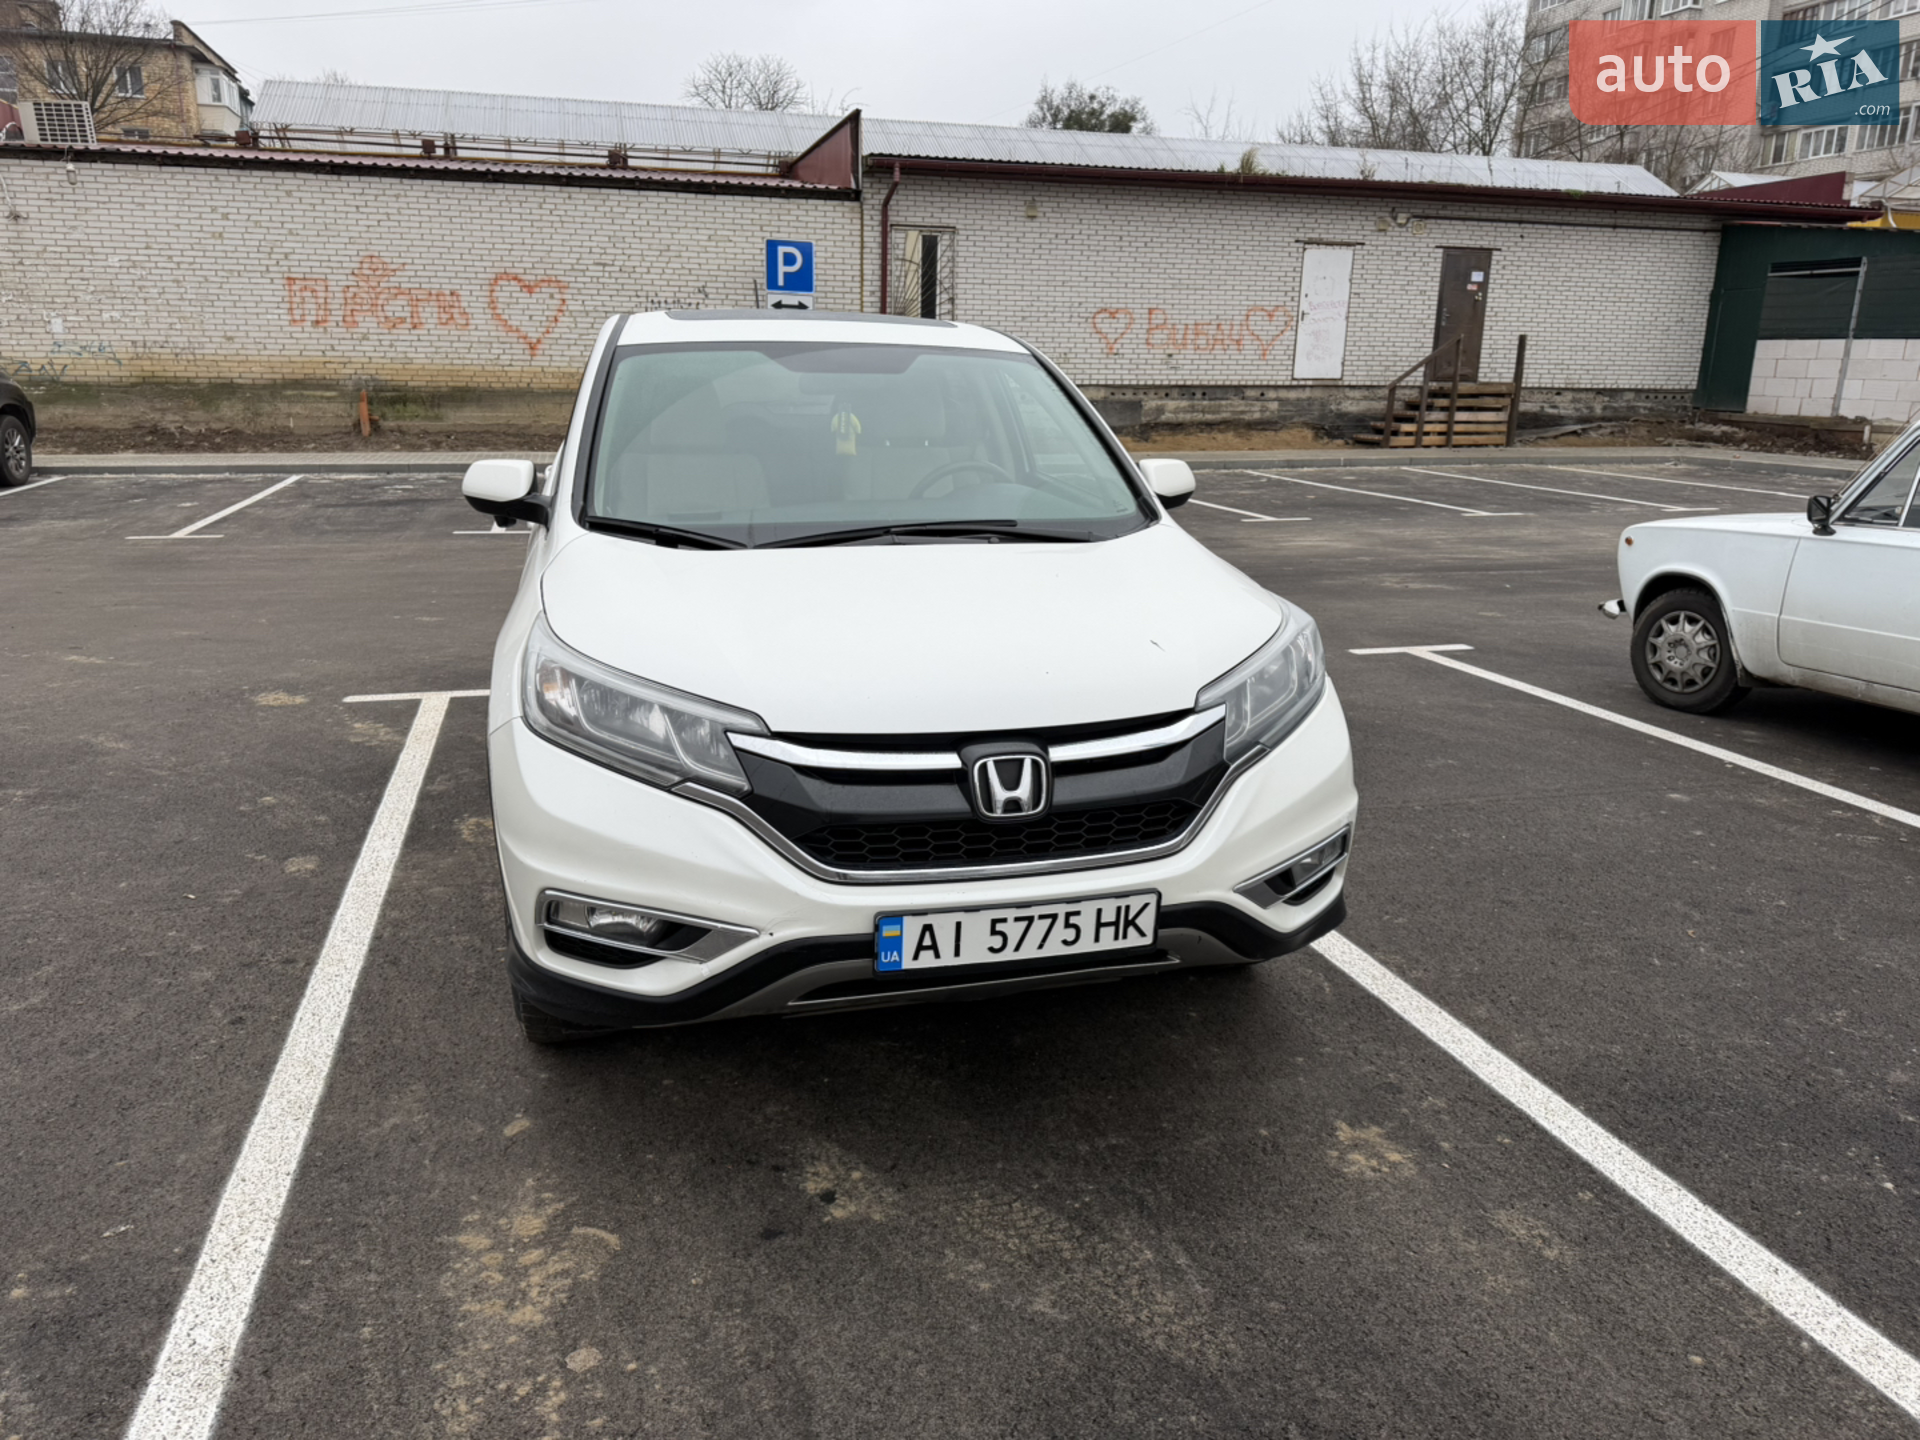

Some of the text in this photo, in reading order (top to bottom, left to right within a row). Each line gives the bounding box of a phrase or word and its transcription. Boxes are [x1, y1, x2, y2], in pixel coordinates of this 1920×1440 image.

[777, 245, 803, 287] P
[912, 902, 1151, 961] AI 5775 HK
[881, 951, 900, 963] UA
